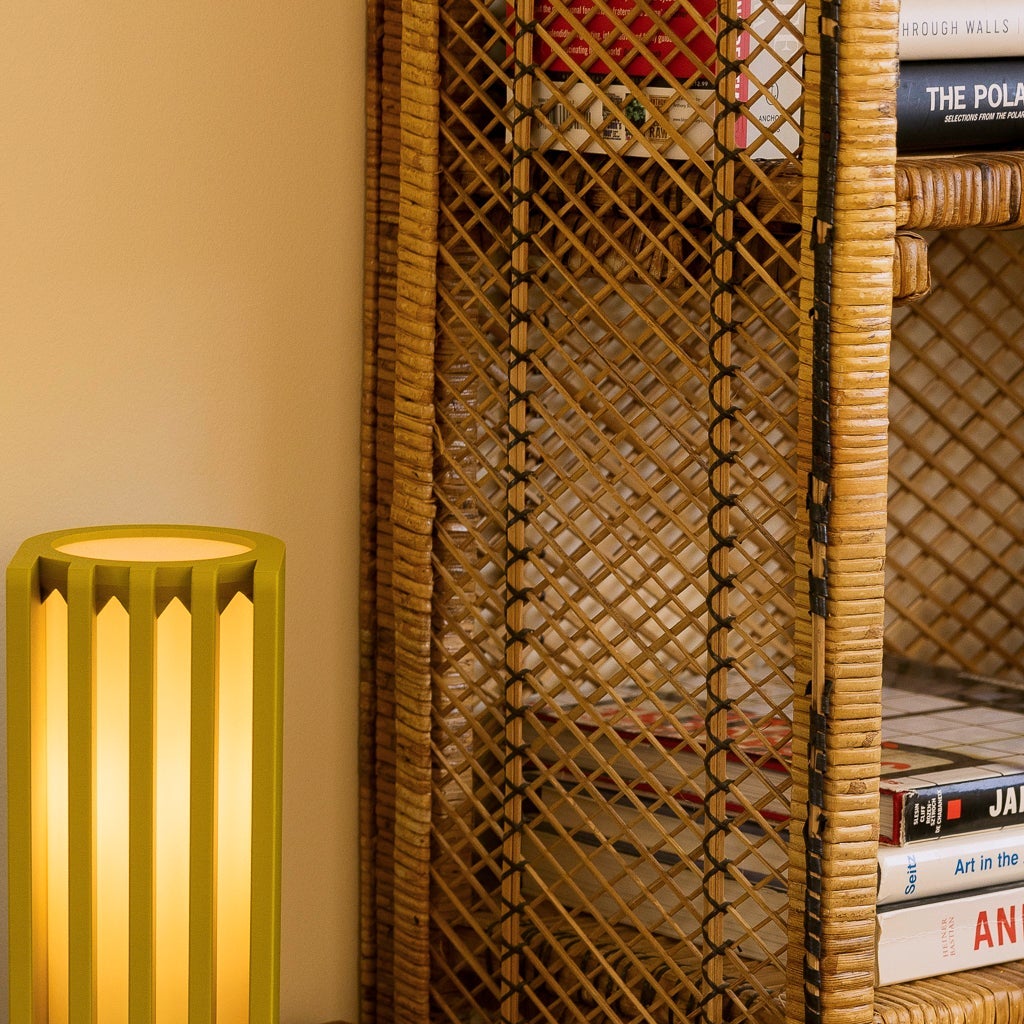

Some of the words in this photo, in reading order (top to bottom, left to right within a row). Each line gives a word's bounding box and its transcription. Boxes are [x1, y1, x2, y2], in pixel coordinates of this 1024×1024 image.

[965, 19, 1009, 34] WALLS
[926, 85, 966, 111] THE
[974, 82, 1024, 108] POLA
[944, 113, 978, 122] SELECTIONS
[978, 112, 995, 120] FROM
[996, 111, 1007, 120] THE
[989, 786, 1024, 818] JA
[905, 854, 917, 895] Seitz
[954, 857, 975, 875] Art
[980, 855, 993, 871] in
[998, 852, 1019, 868] the
[974, 903, 1024, 950] AN
